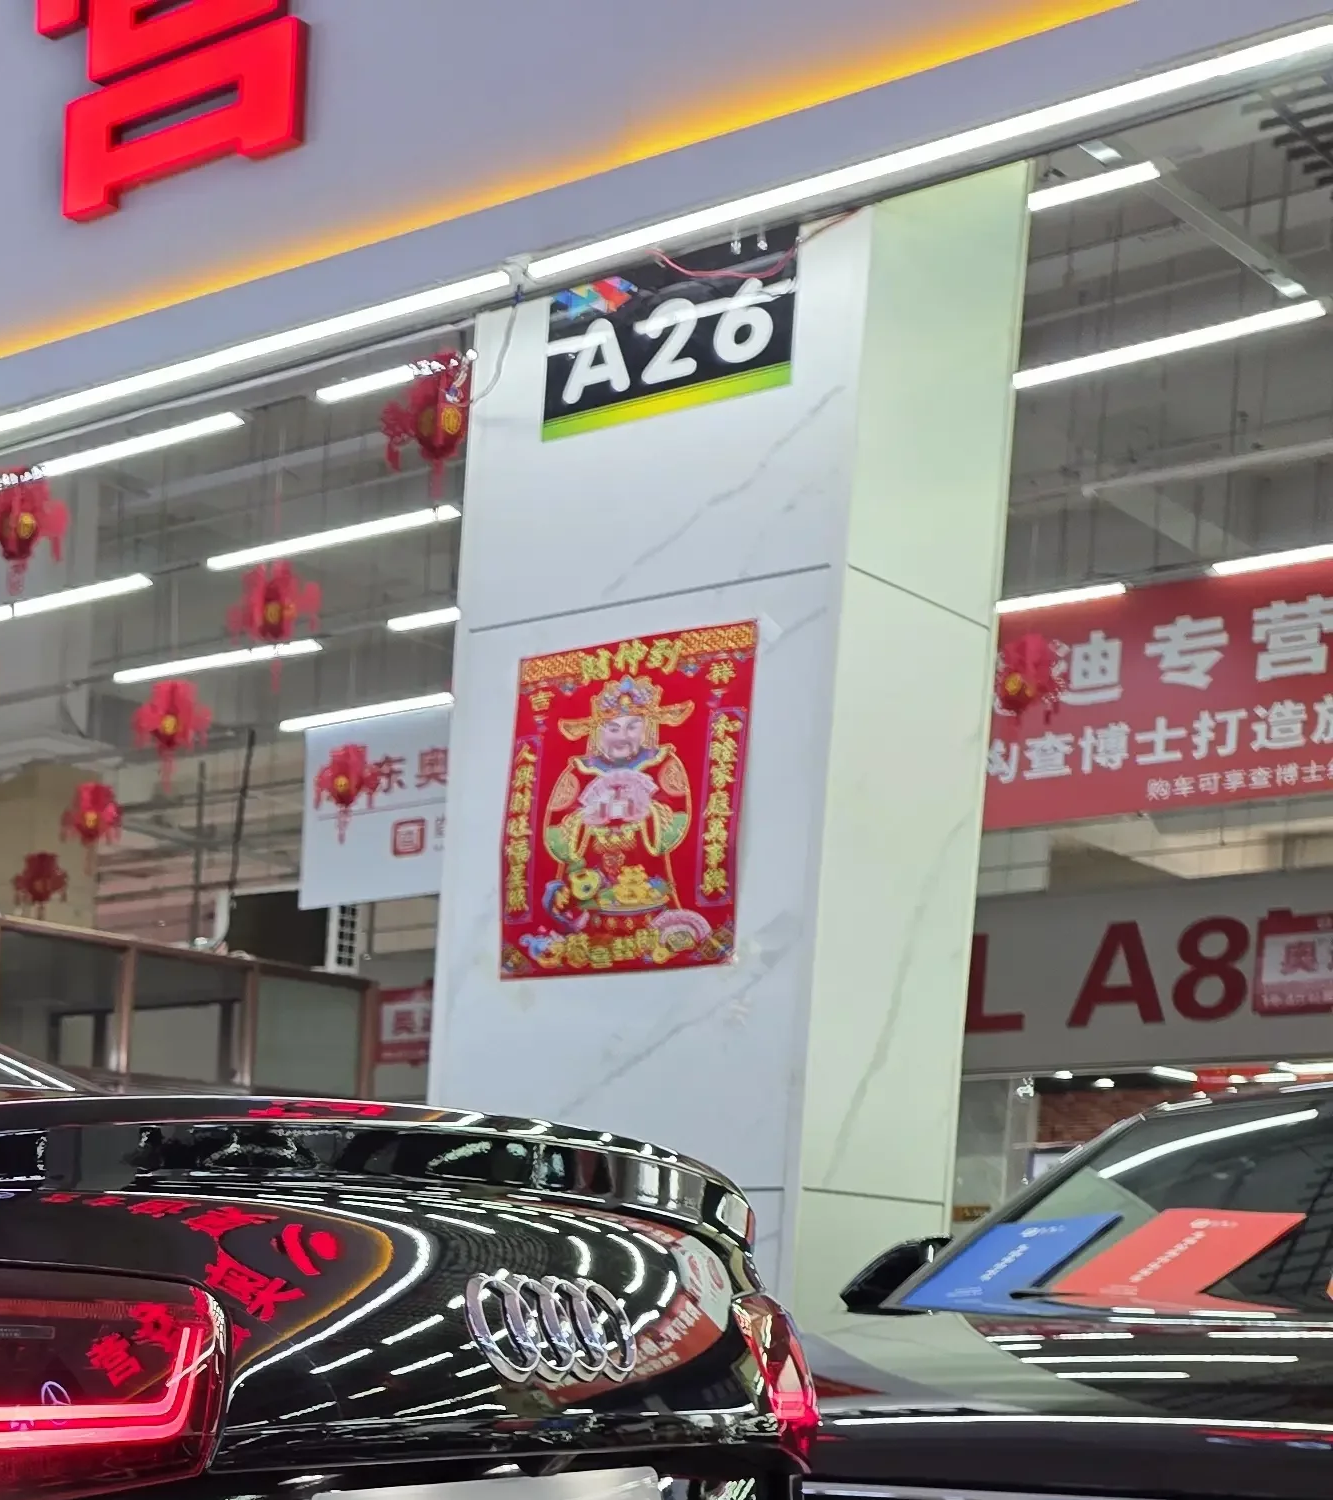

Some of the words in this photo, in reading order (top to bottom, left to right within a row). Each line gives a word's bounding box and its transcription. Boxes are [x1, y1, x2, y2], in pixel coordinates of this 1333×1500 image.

[562, 277, 775, 406] A26
[995, 594, 1333, 705] 迪专营
[1066, 914, 1251, 1030] A8
